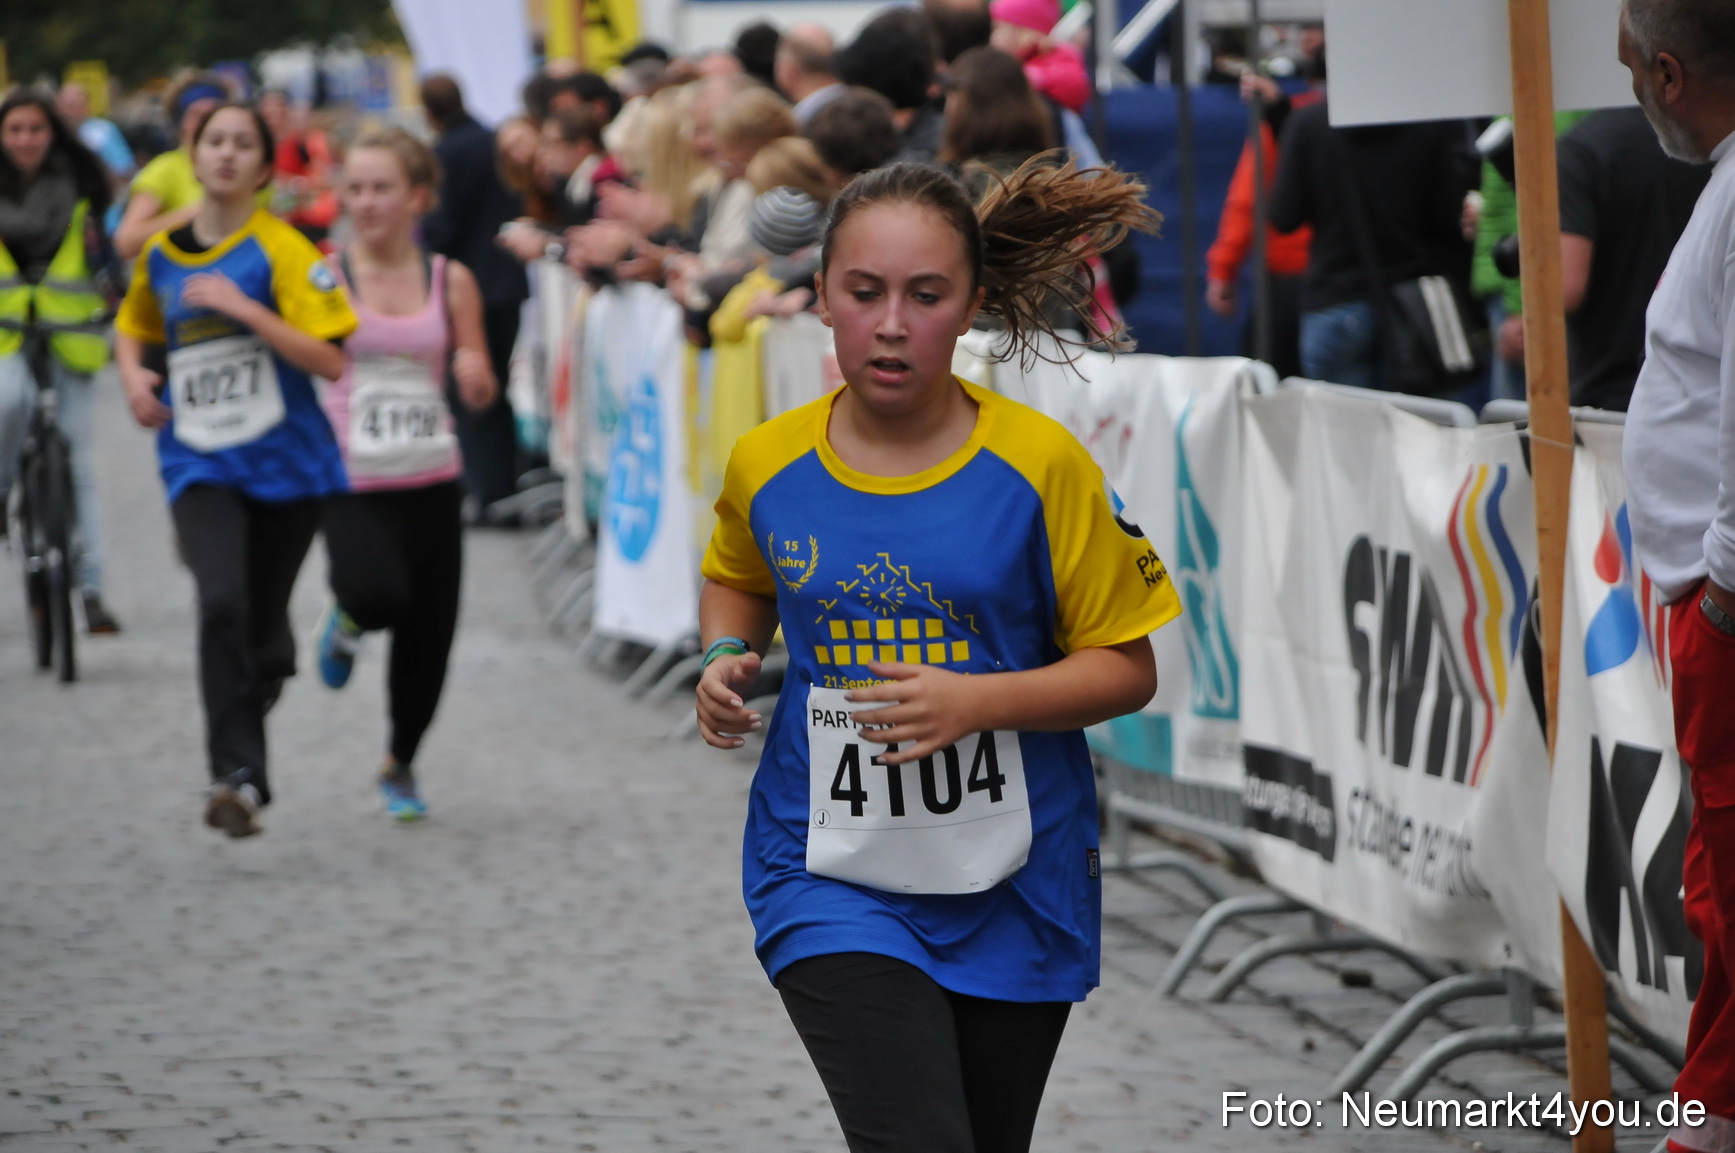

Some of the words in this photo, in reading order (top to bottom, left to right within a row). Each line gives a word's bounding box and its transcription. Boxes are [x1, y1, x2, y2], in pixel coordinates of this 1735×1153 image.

[784, 540, 799, 552] 15
[777, 555, 806, 569] Jahre
[830, 731, 1006, 817] 4104
